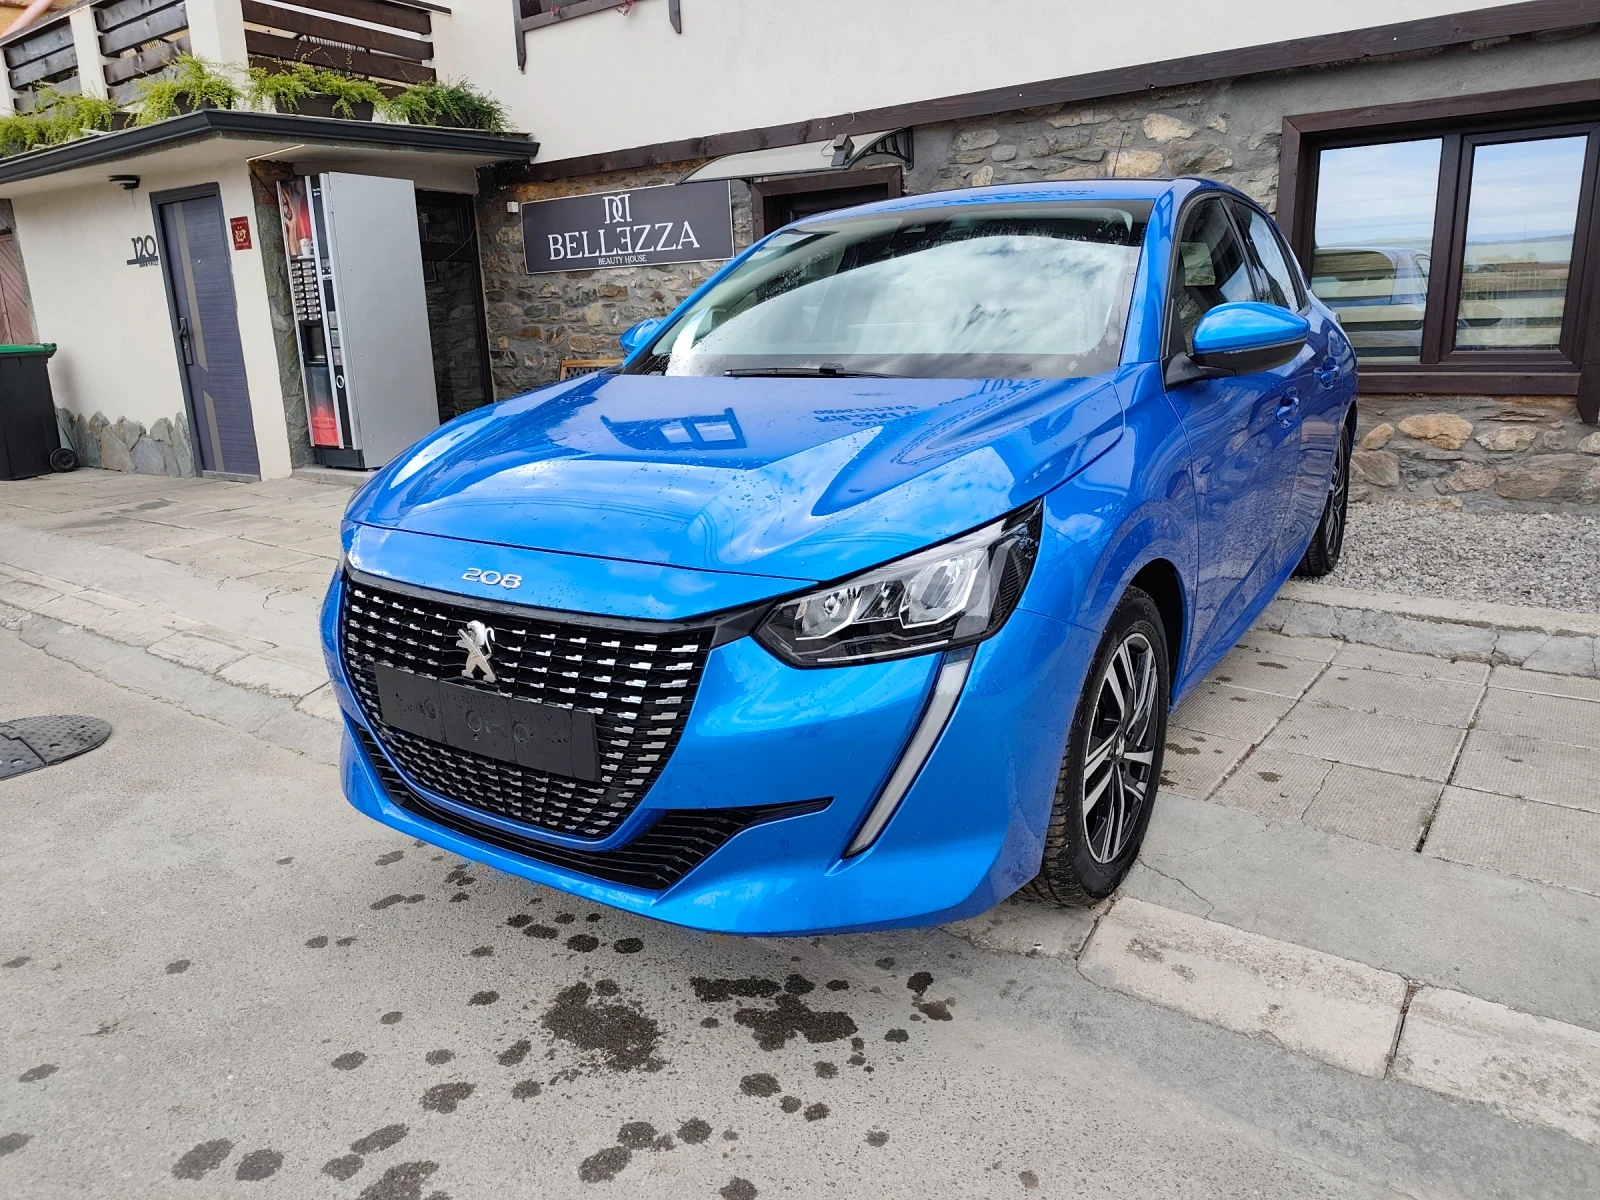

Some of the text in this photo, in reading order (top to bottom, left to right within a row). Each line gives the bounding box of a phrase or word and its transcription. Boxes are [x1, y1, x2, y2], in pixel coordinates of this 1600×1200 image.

[598, 254, 647, 266] BEAUTY HOUSE
[461, 567, 523, 589] 208
